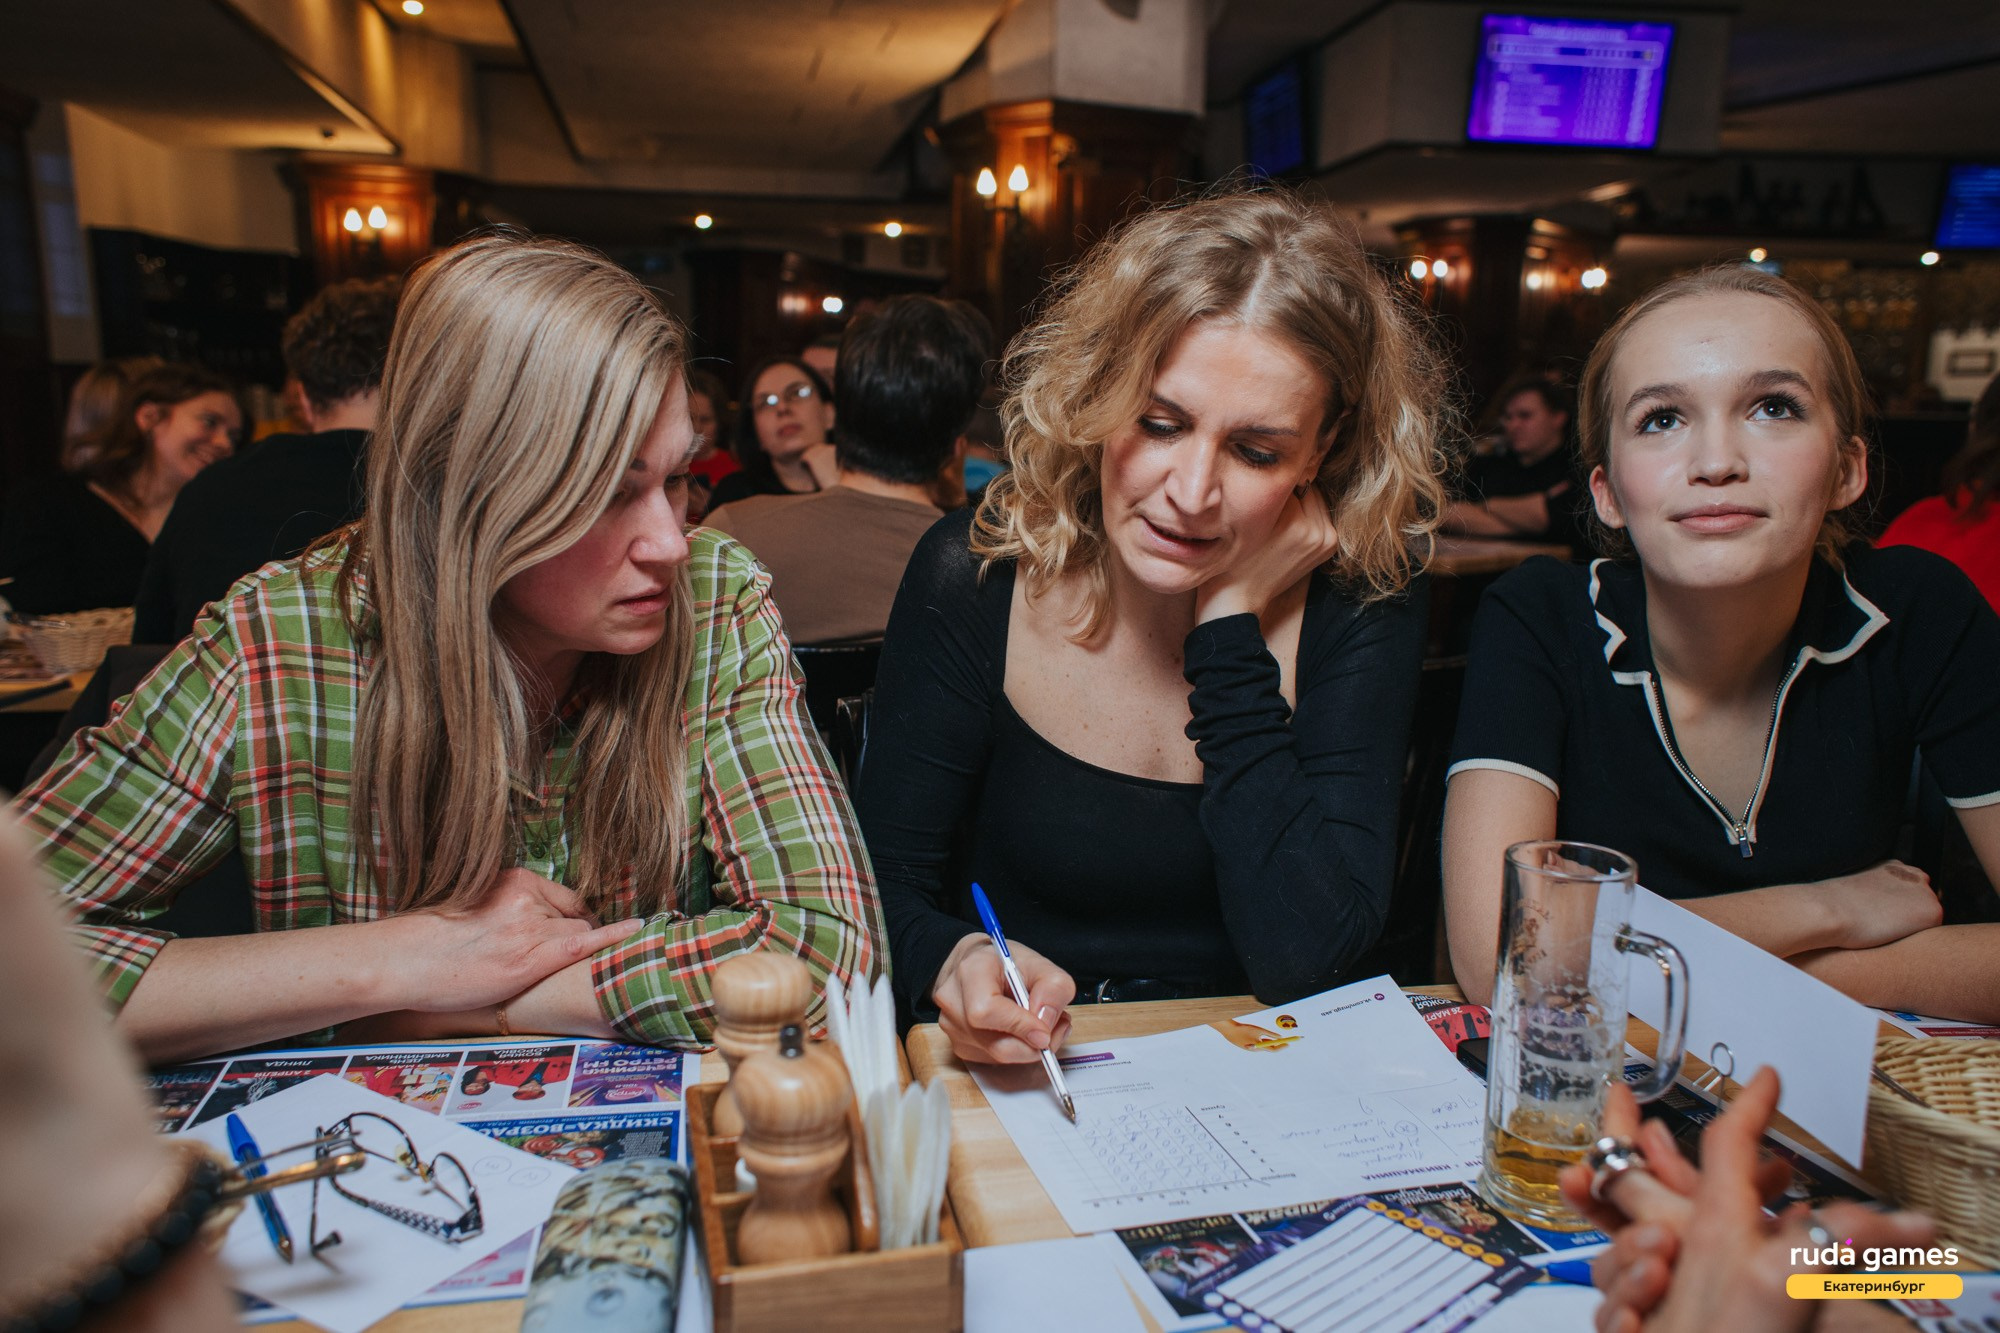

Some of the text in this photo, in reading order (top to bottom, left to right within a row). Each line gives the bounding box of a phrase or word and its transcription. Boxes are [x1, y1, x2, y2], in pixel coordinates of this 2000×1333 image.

[1451, 1006, 1463, 1015] 26
[493, 1047, 549, 1055] КОРОВКА
[365, 1053, 450, 1061] ИМЕНИННИКА
[493, 1058, 531, 1066] МАРТА
[584, 1057, 677, 1070] РЕТРО FM
[254, 1070, 304, 1078] АПРЕЛЯ
[582, 1064, 677, 1075] ВЕЧЕРИНКА
[1362, 1164, 1452, 1181] КВИЗМАШИНА
[1381, 1186, 1428, 1201] радост
